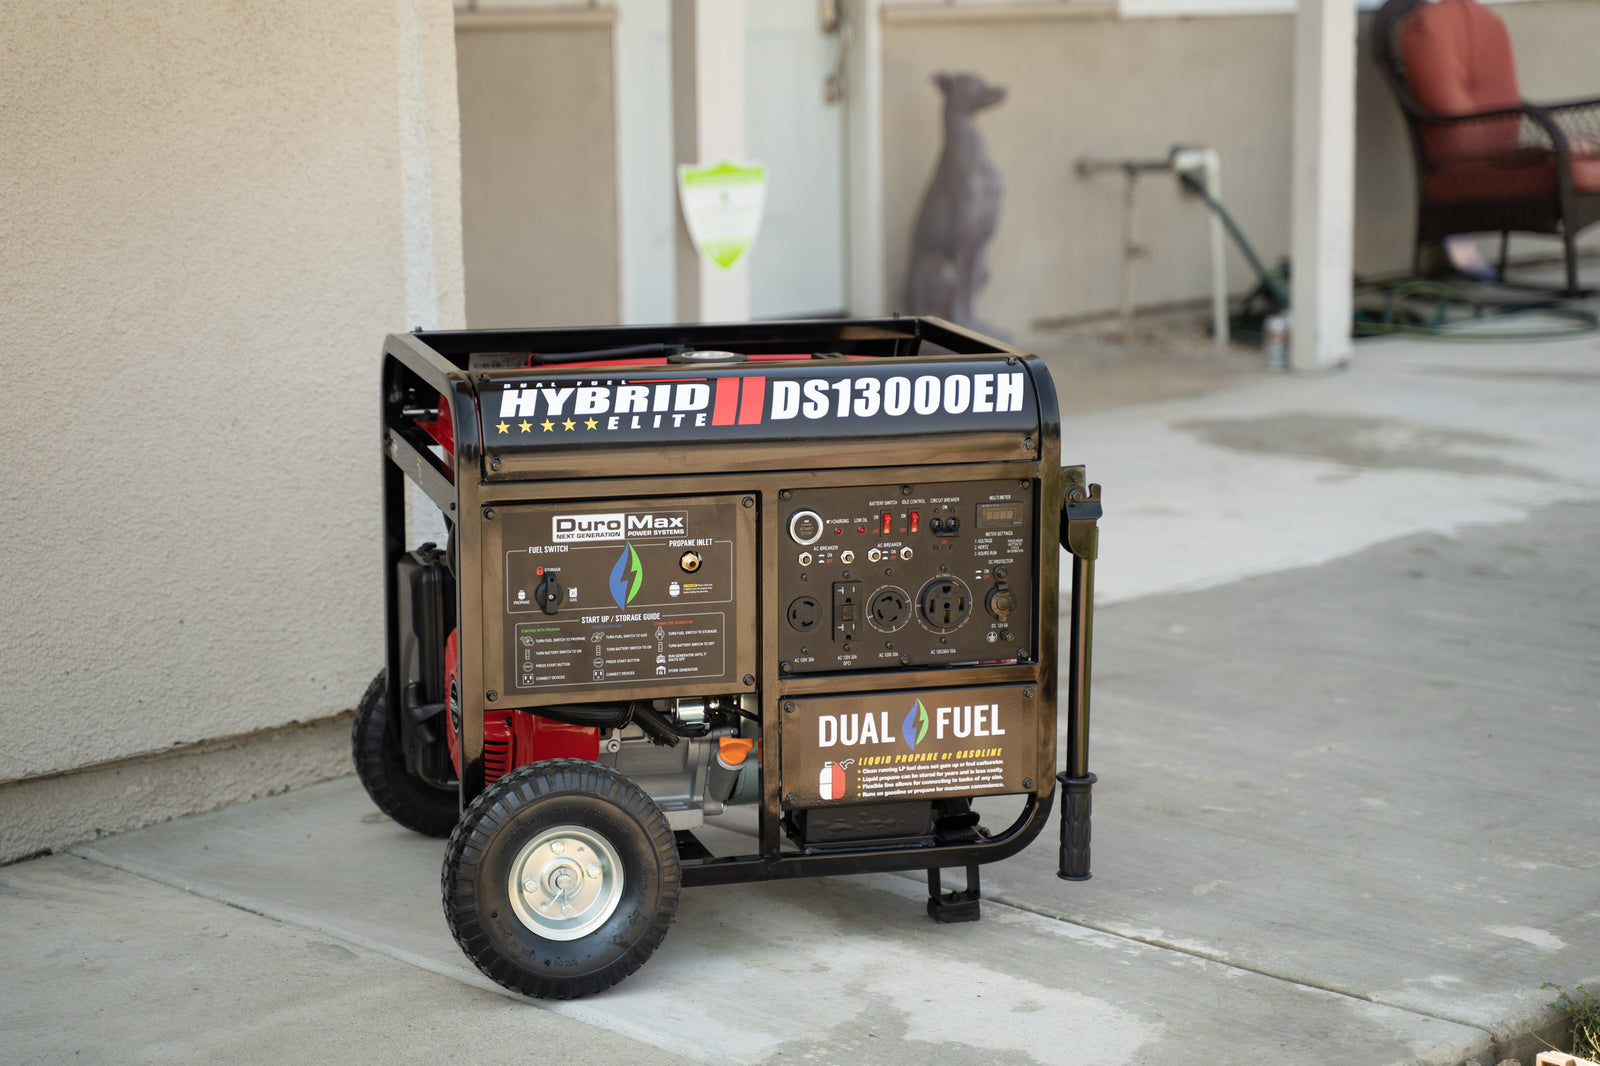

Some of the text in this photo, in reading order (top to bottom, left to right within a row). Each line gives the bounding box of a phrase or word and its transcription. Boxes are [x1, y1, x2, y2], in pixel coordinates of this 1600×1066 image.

[499, 384, 711, 418] HYBRID
[770, 372, 1024, 420] DS13000EH
[607, 413, 707, 430] ELITE
[544, 545, 568, 553] SWITCH
[581, 616, 600, 624] START
[616, 614, 642, 622] STORAGE
[642, 612, 660, 620] GUIDE
[818, 704, 1006, 748] DUAL FUEL
[858, 748, 1002, 766] LIQUID PROPANE or GASOLINE
